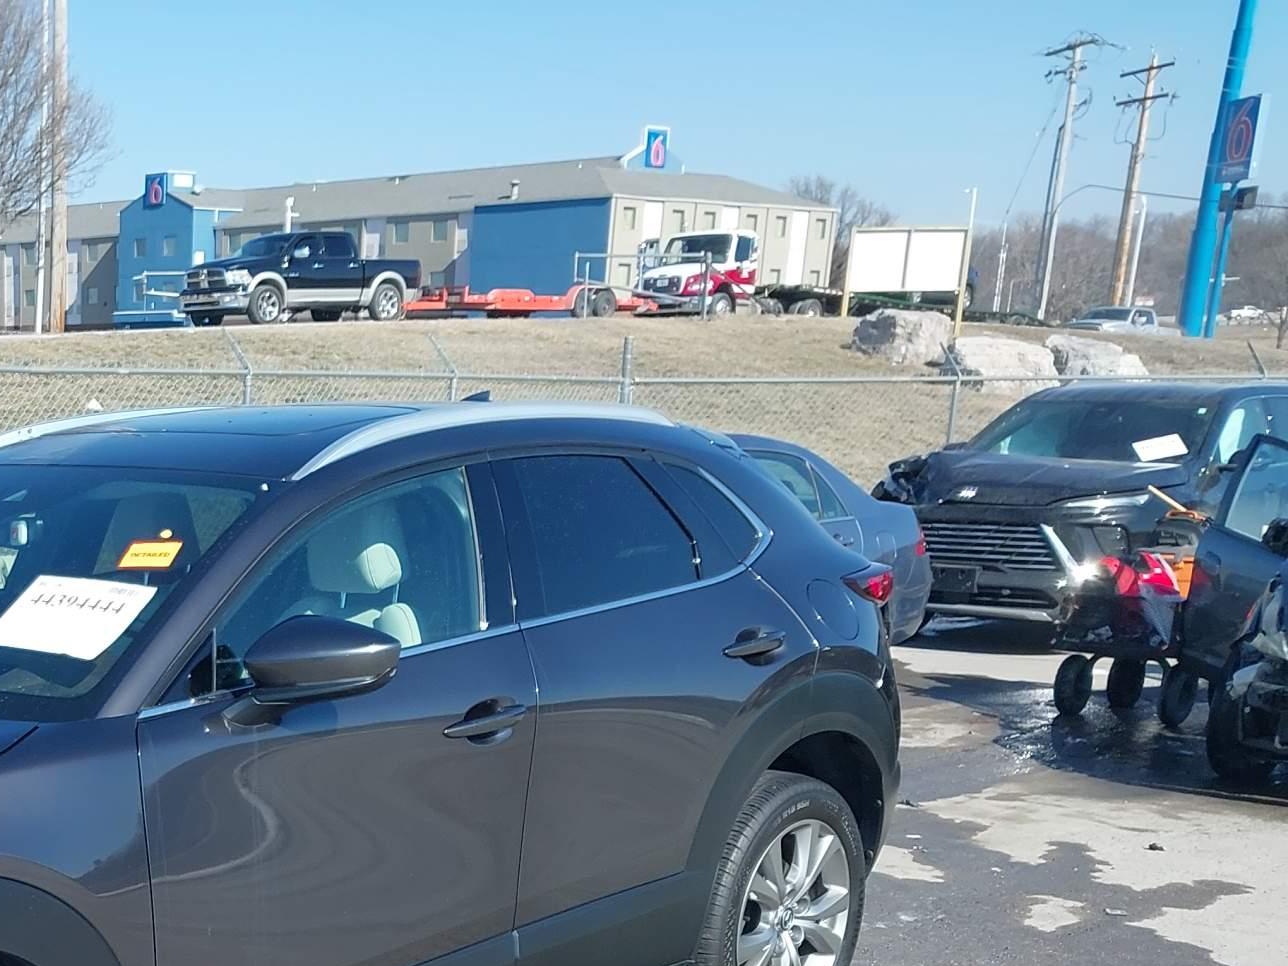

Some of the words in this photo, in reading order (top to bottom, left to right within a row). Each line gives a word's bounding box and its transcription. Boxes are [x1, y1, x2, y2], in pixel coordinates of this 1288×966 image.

[1226, 98, 1252, 163] 6
[651, 135, 665, 166] 6
[150, 177, 162, 204] 6
